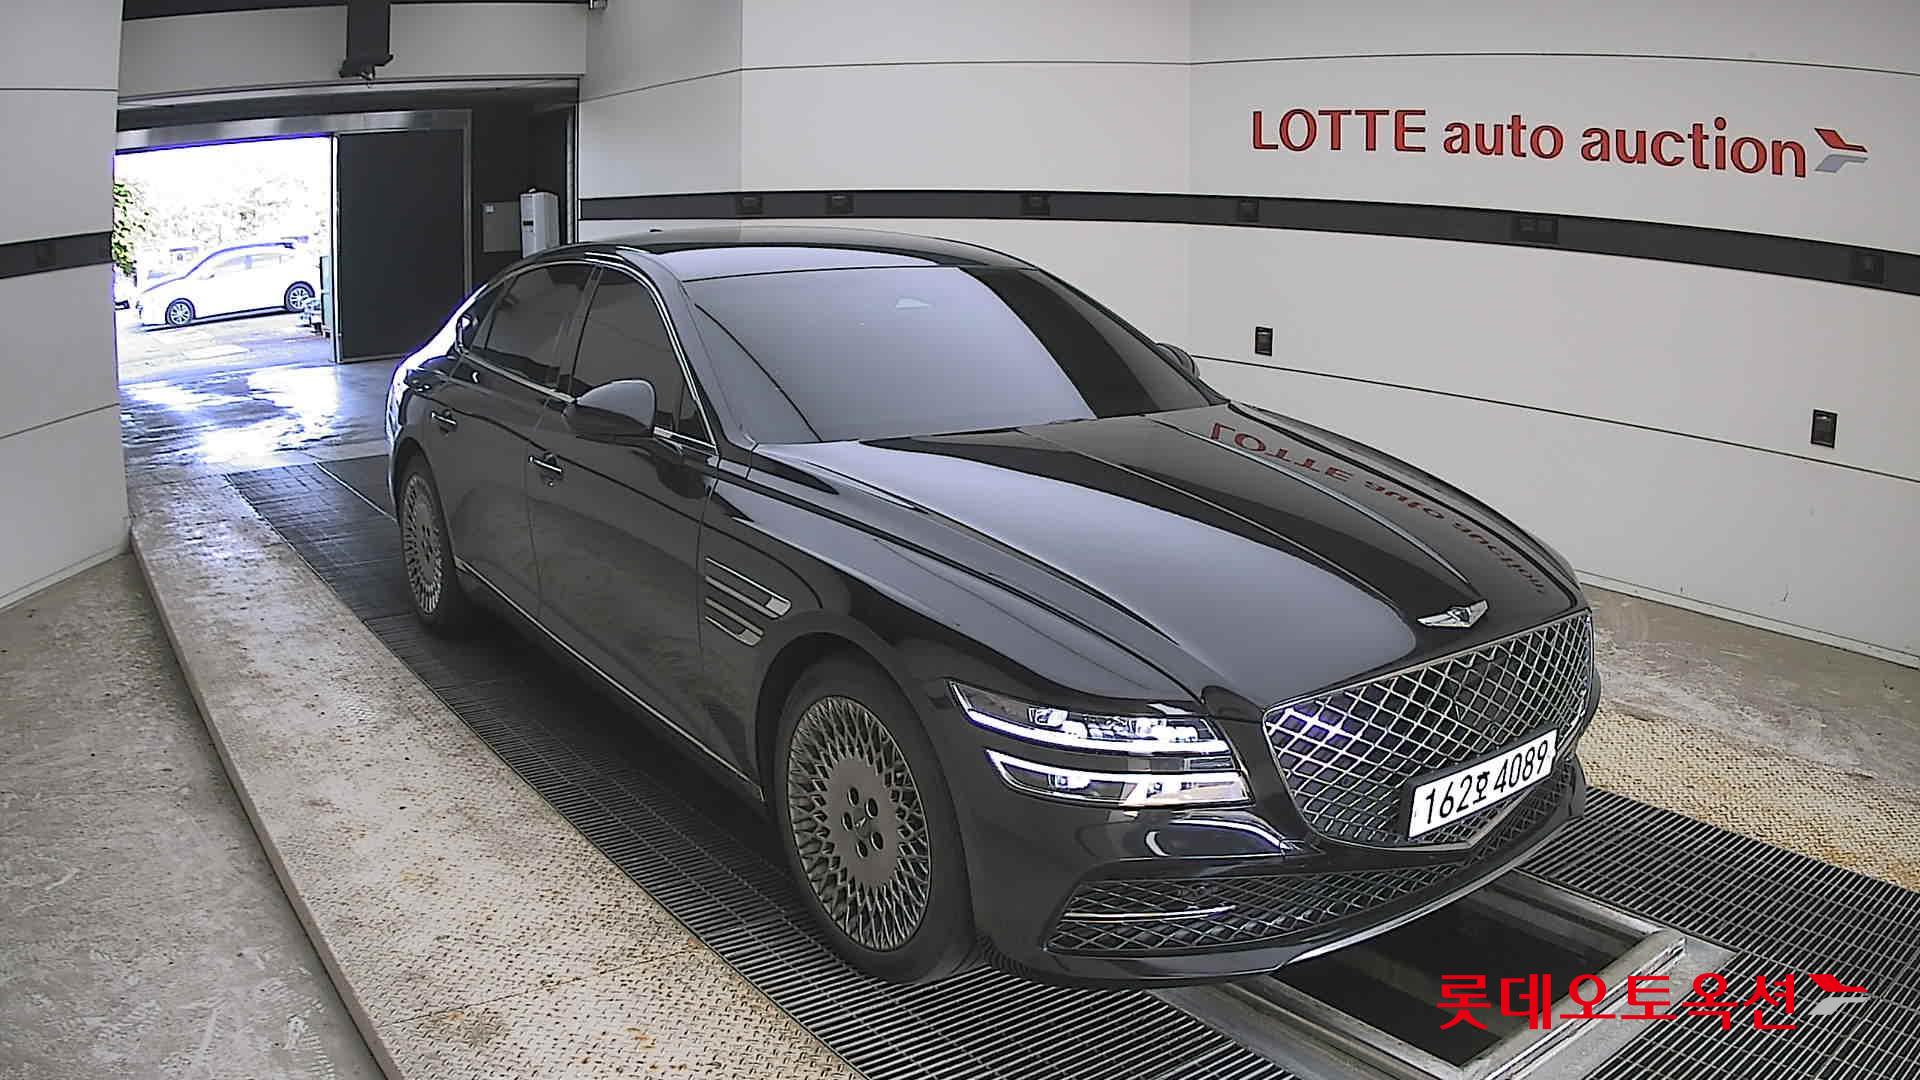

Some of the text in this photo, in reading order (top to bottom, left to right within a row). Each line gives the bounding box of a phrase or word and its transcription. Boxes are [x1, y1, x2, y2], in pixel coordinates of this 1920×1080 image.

[1252, 108, 1809, 178] LOTTE auto auction
